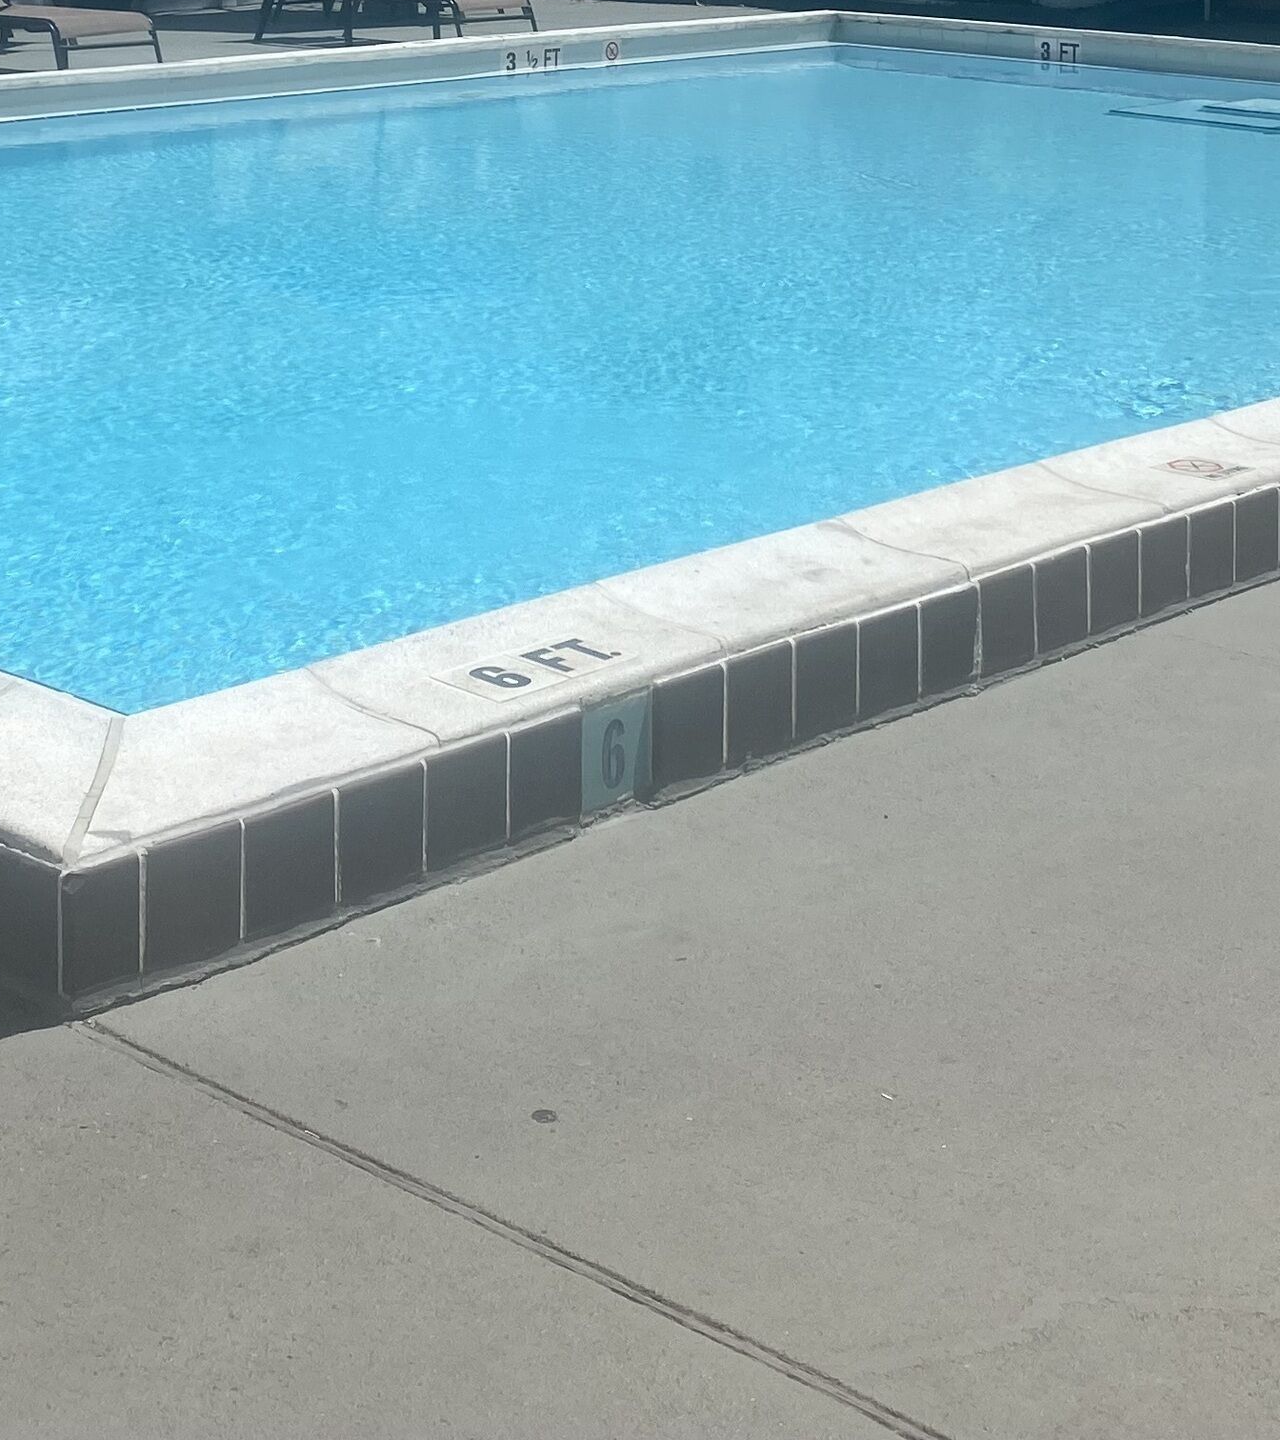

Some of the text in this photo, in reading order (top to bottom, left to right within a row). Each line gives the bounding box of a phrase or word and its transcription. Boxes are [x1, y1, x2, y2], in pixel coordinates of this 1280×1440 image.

[505, 51, 516, 71] 3
[543, 47, 561, 68] FT
[1041, 41, 1080, 63] 3 FT
[469, 666, 532, 689] 6
[601, 718, 625, 790] 6
